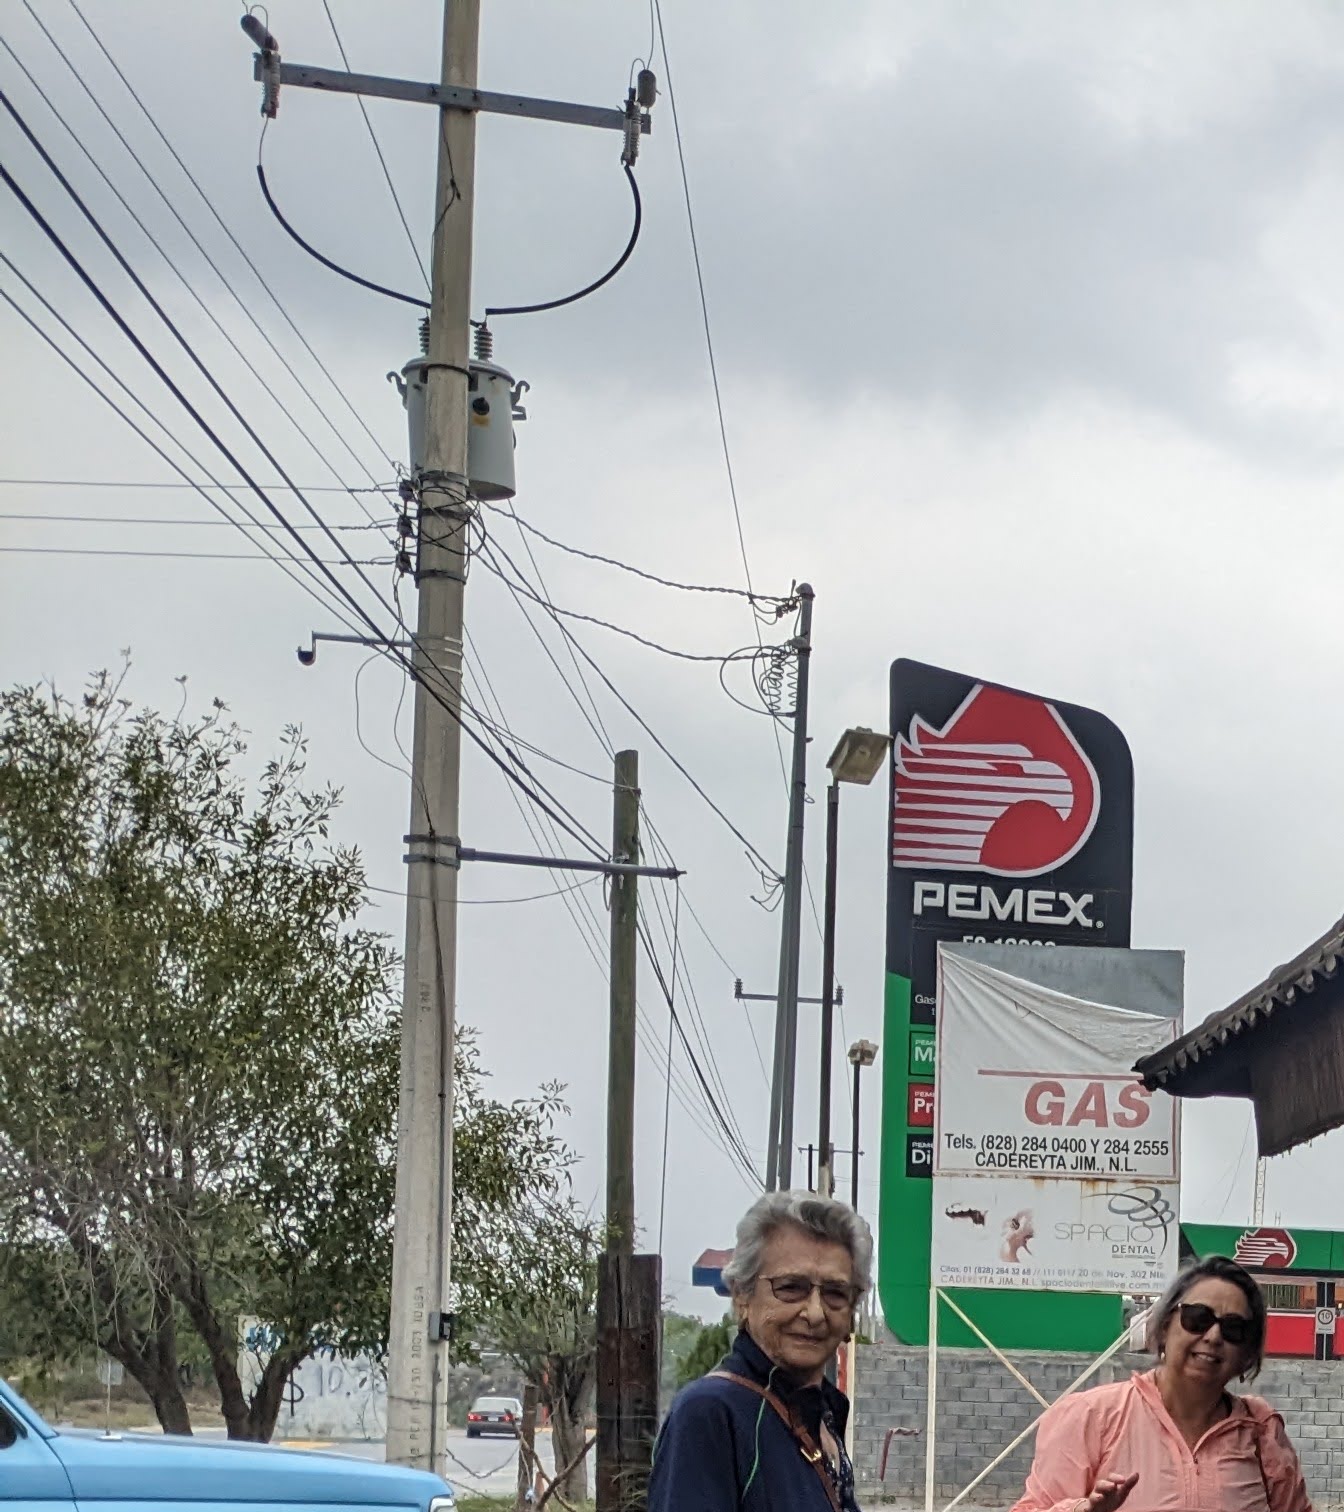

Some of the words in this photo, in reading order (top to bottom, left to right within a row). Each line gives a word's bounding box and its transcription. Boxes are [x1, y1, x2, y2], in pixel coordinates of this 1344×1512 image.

[914, 993, 936, 1005] Gas
[913, 1098, 935, 1114] Pr
[1024, 1080, 1153, 1129] GAS
[945, 1133, 977, 1150] Tels.
[981, 1134, 1018, 1154] (828)
[1021, 1136, 1047, 1152] 284
[1051, 1137, 1087, 1153] 0400
[1090, 1138, 1100, 1153] Y
[1103, 1138, 1130, 1155] 284
[1133, 1139, 1169, 1156] 2555
[911, 1148, 933, 1165] Di
[975, 1152, 1067, 1170] CADEREYTA
[1108, 1157, 1137, 1172] N.L.
[1054, 1222, 1154, 1243] SPACIO
[1111, 1244, 1156, 1255] DENTAL
[1079, 1269, 1089, 1277] 20
[1130, 1270, 1147, 1279] 302
